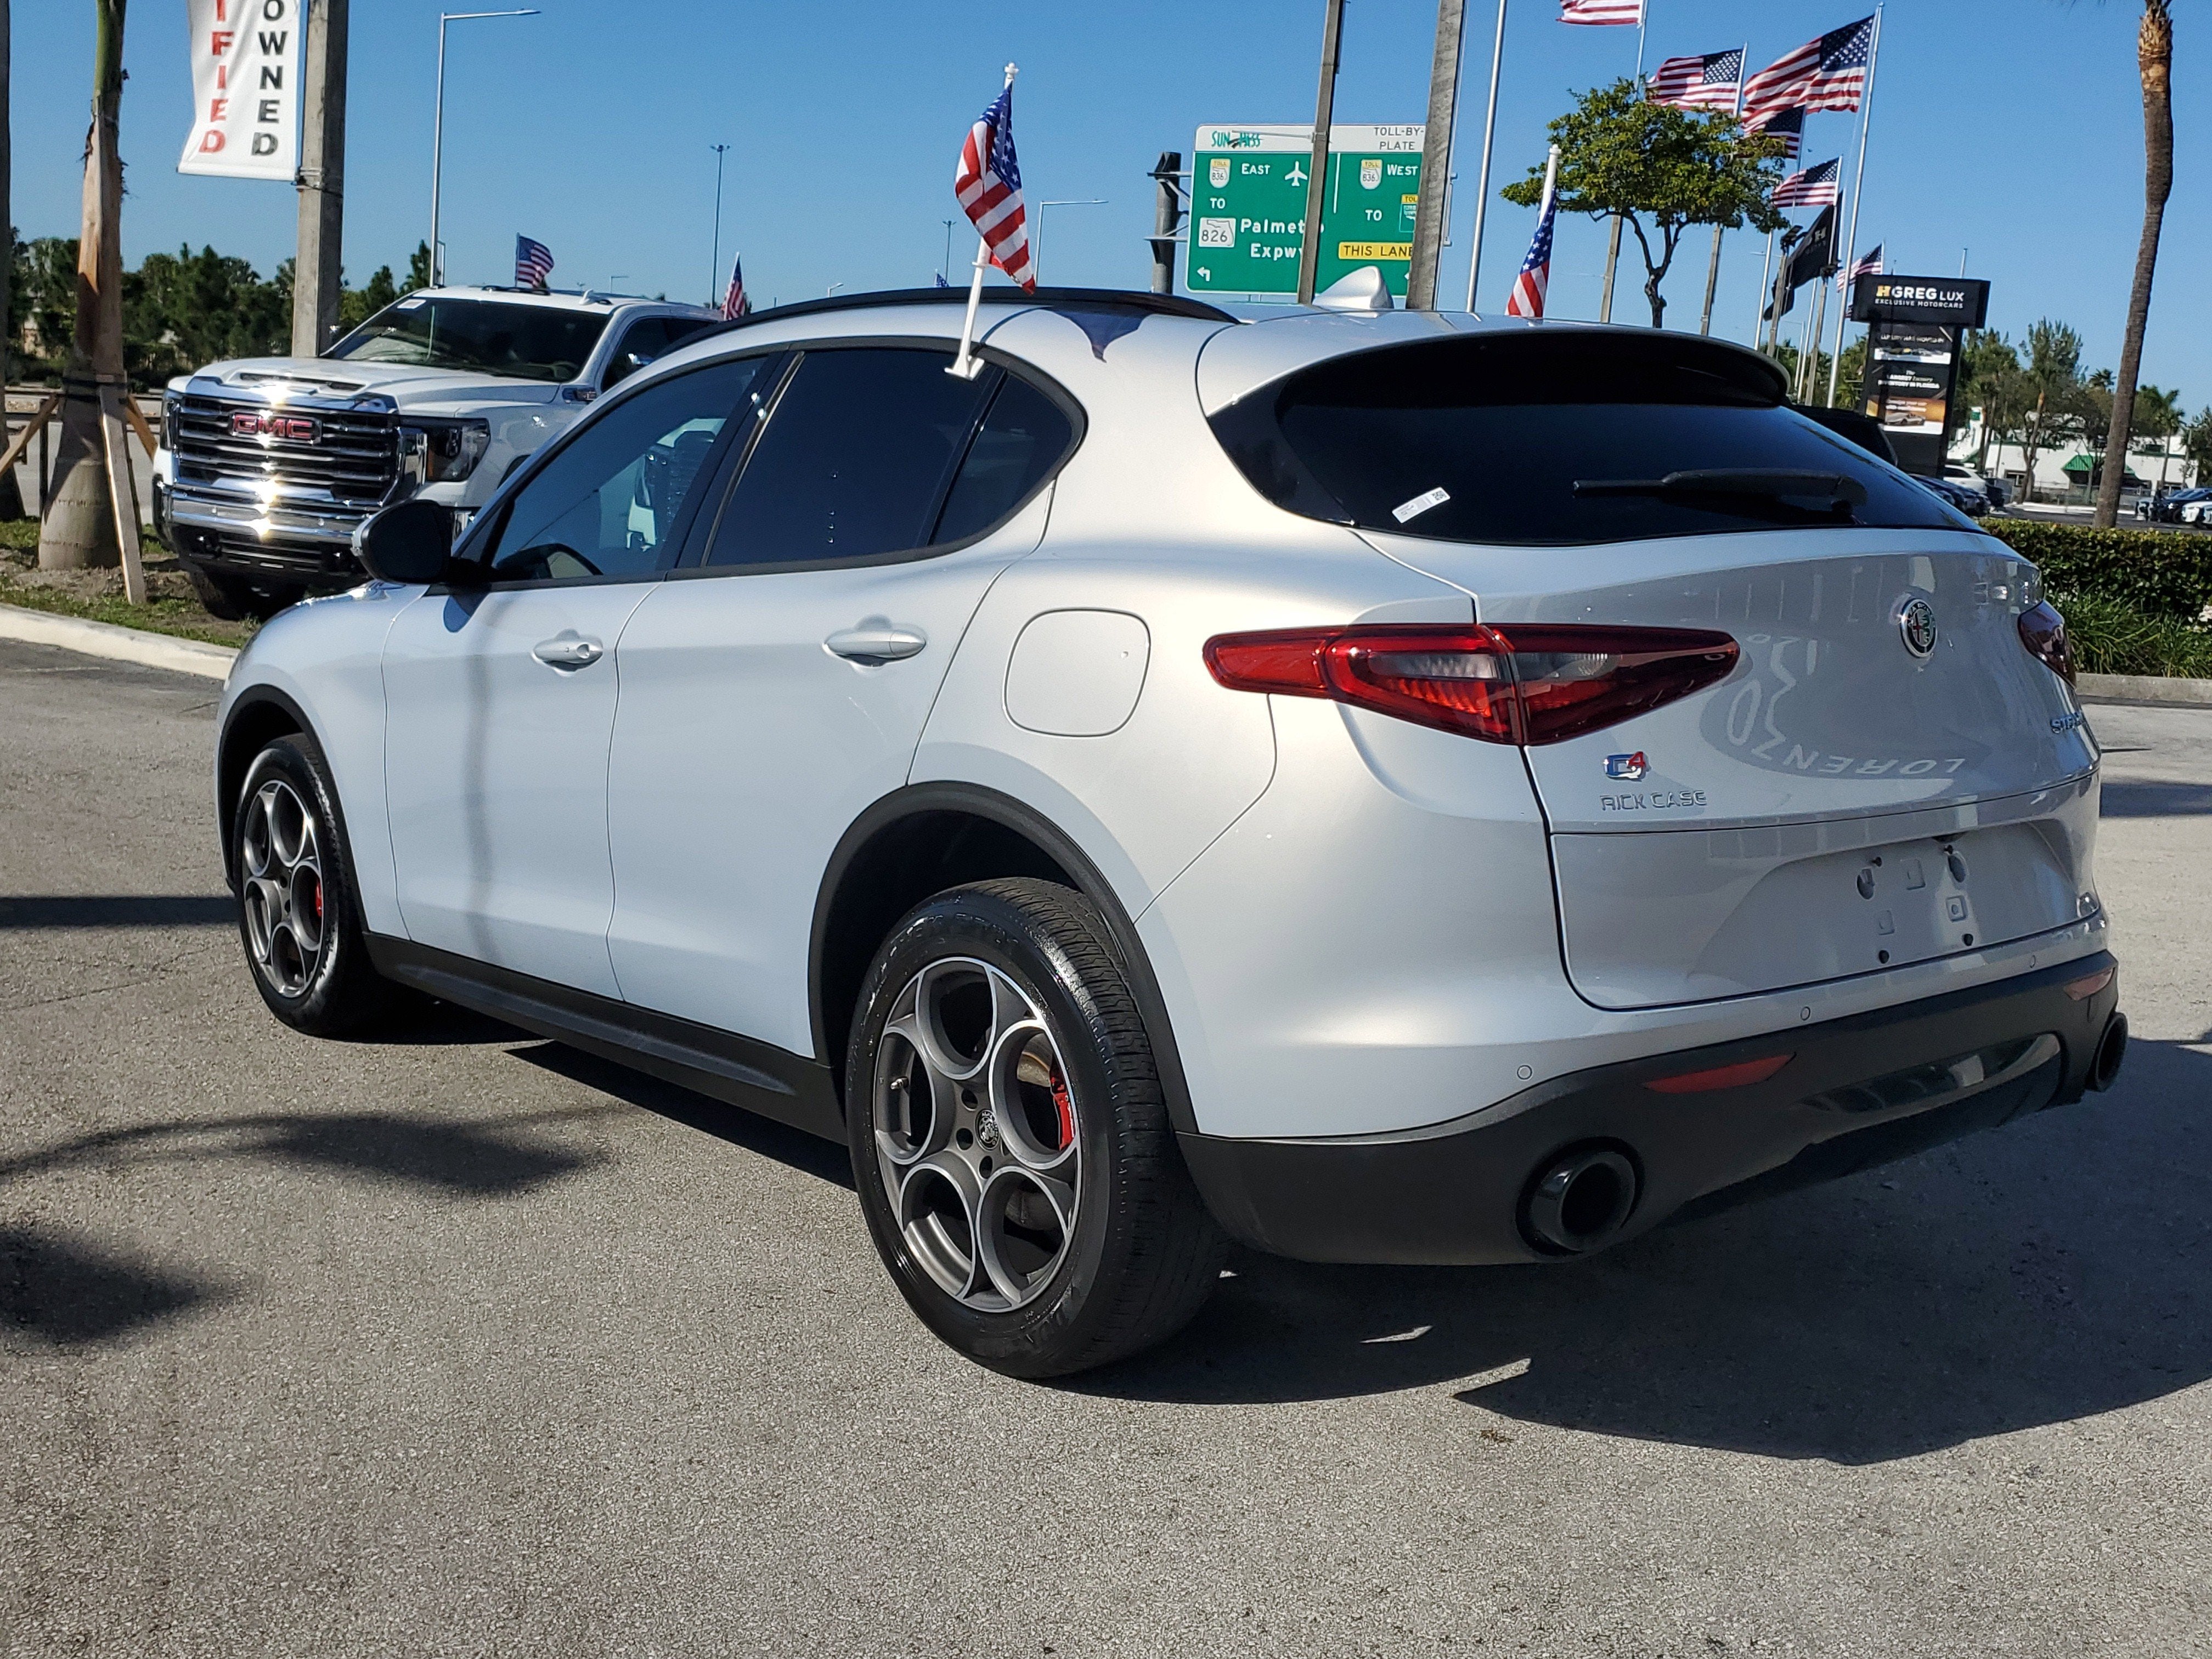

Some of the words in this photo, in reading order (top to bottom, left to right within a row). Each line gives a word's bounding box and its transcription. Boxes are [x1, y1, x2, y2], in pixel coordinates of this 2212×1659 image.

[251, 0, 288, 156] OWNED
[1374, 127, 1424, 136] TOLL-BY-
[1379, 141, 1415, 150] PLATE
[1241, 163, 1271, 174] EAST
[1387, 164, 1419, 176] WEST
[1212, 172, 1224, 180] 836
[1363, 173, 1375, 182] 836
[1210, 198, 1226, 209] TO
[1365, 210, 1383, 221] TO
[1201, 230, 1228, 242] 826
[1344, 245, 1373, 256] THIS
[1939, 291, 1965, 301] LUX
[234, 414, 313, 439] GMC
[1604, 751, 1645, 780] Q4
[1600, 794, 1646, 811] RICK
[1650, 791, 1707, 808] CASE
